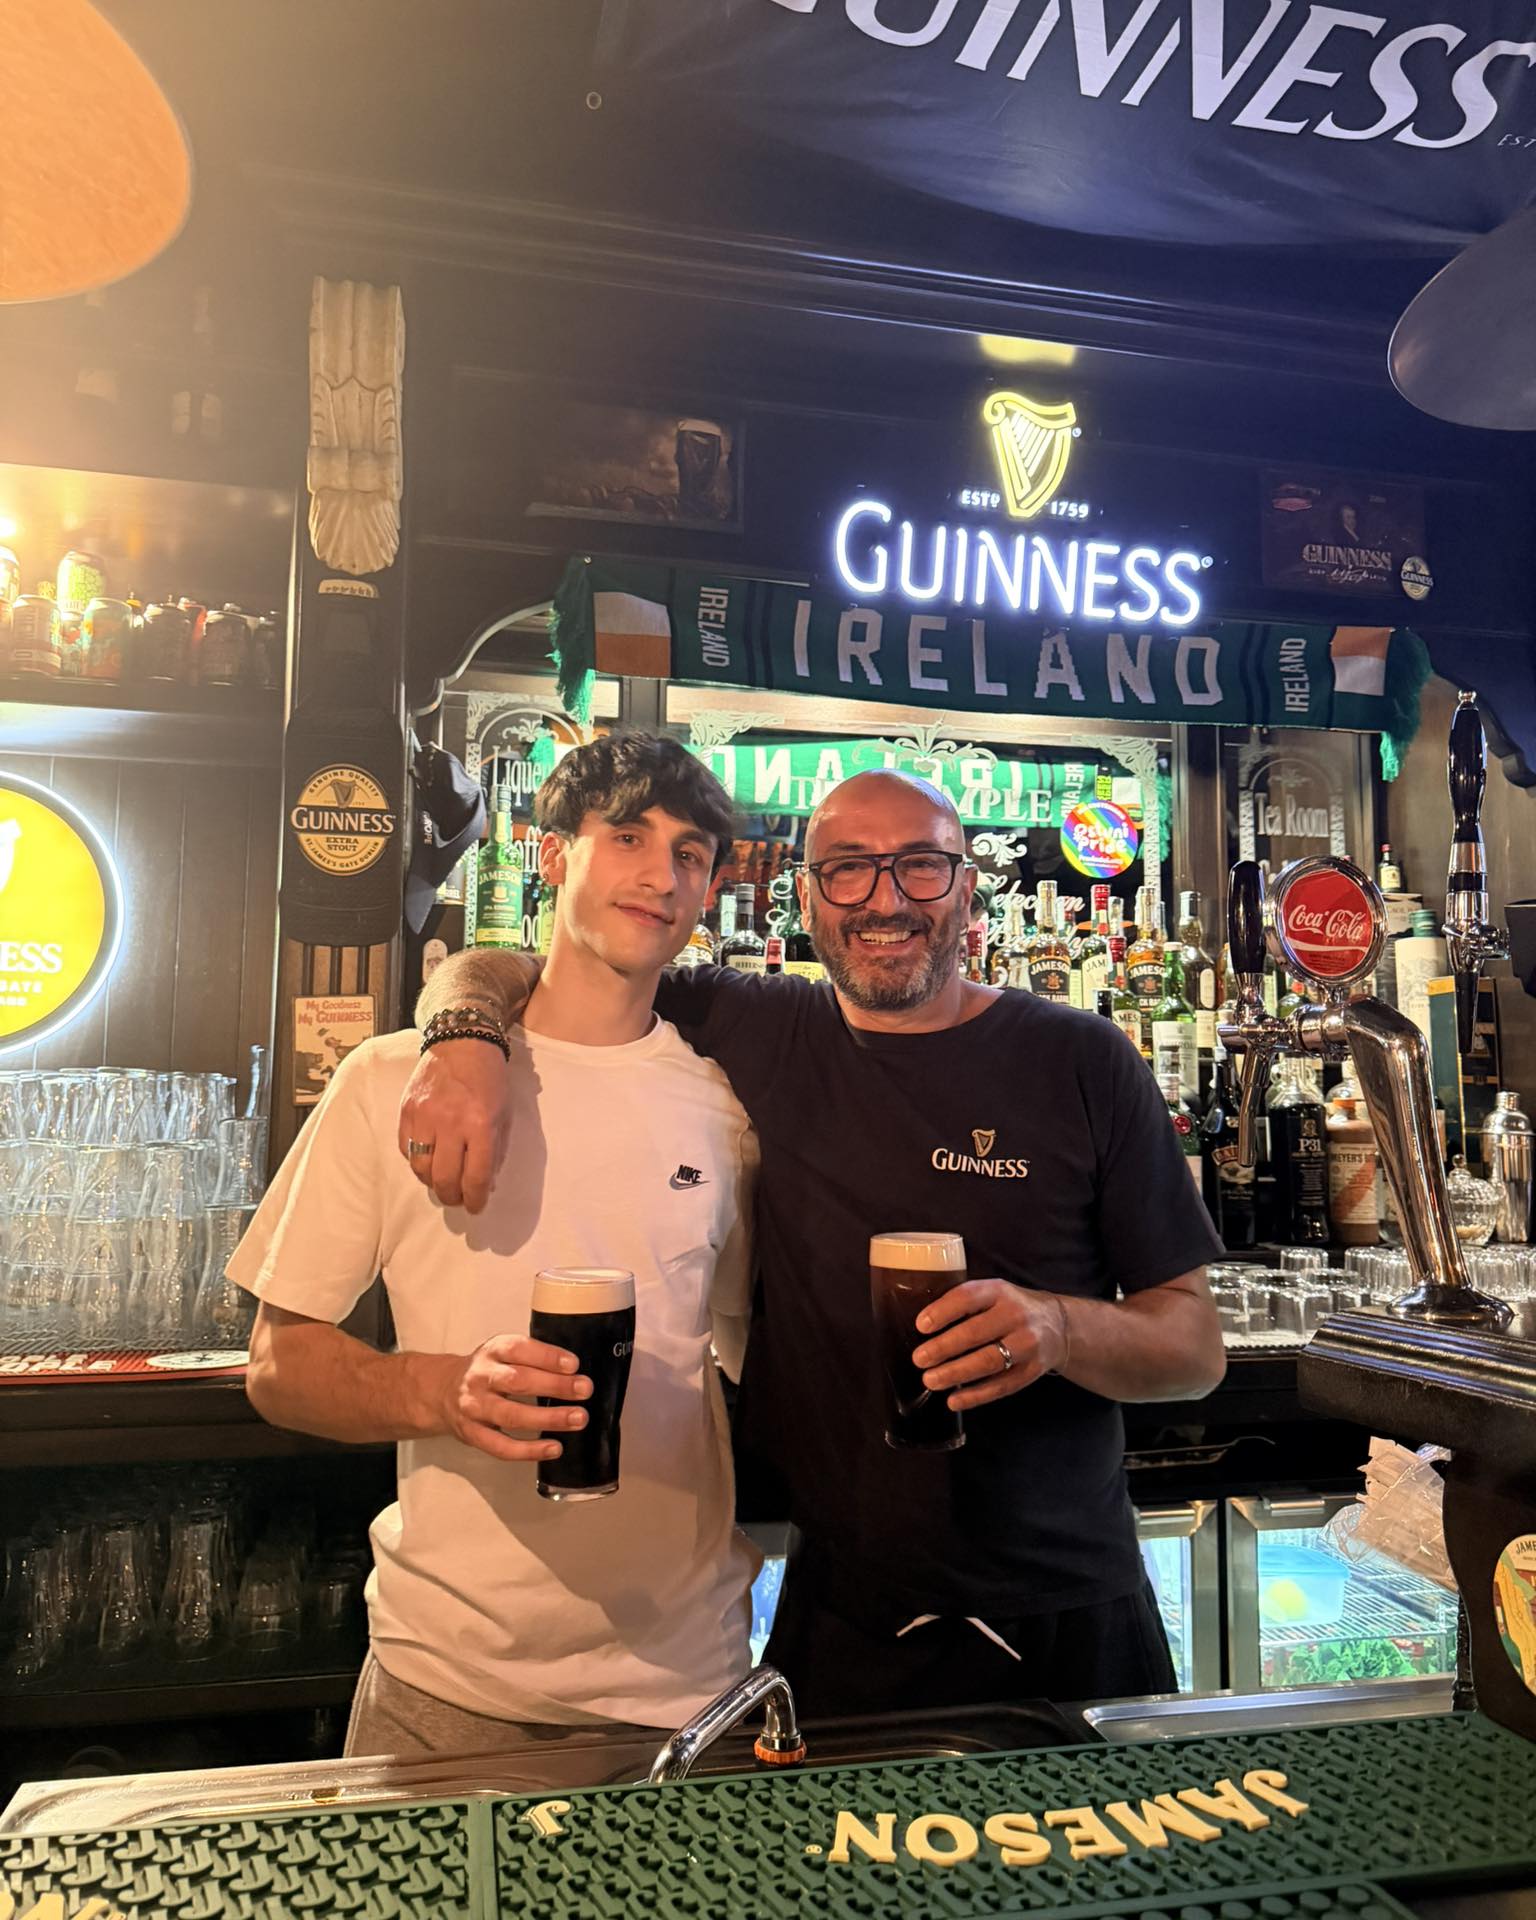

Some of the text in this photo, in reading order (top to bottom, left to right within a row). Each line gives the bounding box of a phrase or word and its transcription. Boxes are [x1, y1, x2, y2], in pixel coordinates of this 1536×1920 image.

[771, 0, 1536, 149] INNESS
[1050, 501, 1089, 518] 1759
[835, 501, 1201, 625] GUINNESS
[1302, 543, 1392, 571] GUINNESS
[1400, 569, 1434, 587] GUINNESS
[697, 586, 730, 668] IRELAND
[794, 600, 1224, 707] IRELAND
[1279, 637, 1308, 713] IRELAND
[308, 771, 380, 797] GENUINE QUALITY
[290, 806, 395, 834] GUINNESS
[1255, 792, 1330, 838] Tea Room
[326, 837, 359, 845] EXTRA
[327, 844, 357, 852] STOUT
[298, 1010, 373, 1026] My GUINNESS
[305, 1000, 319, 1012] My
[1298, 1138, 1322, 1152] P31
[677, 1164, 702, 1184] NIKE
[931, 1147, 1029, 1178] GUINNESS
[828, 1769, 1310, 1868] JAMESON
